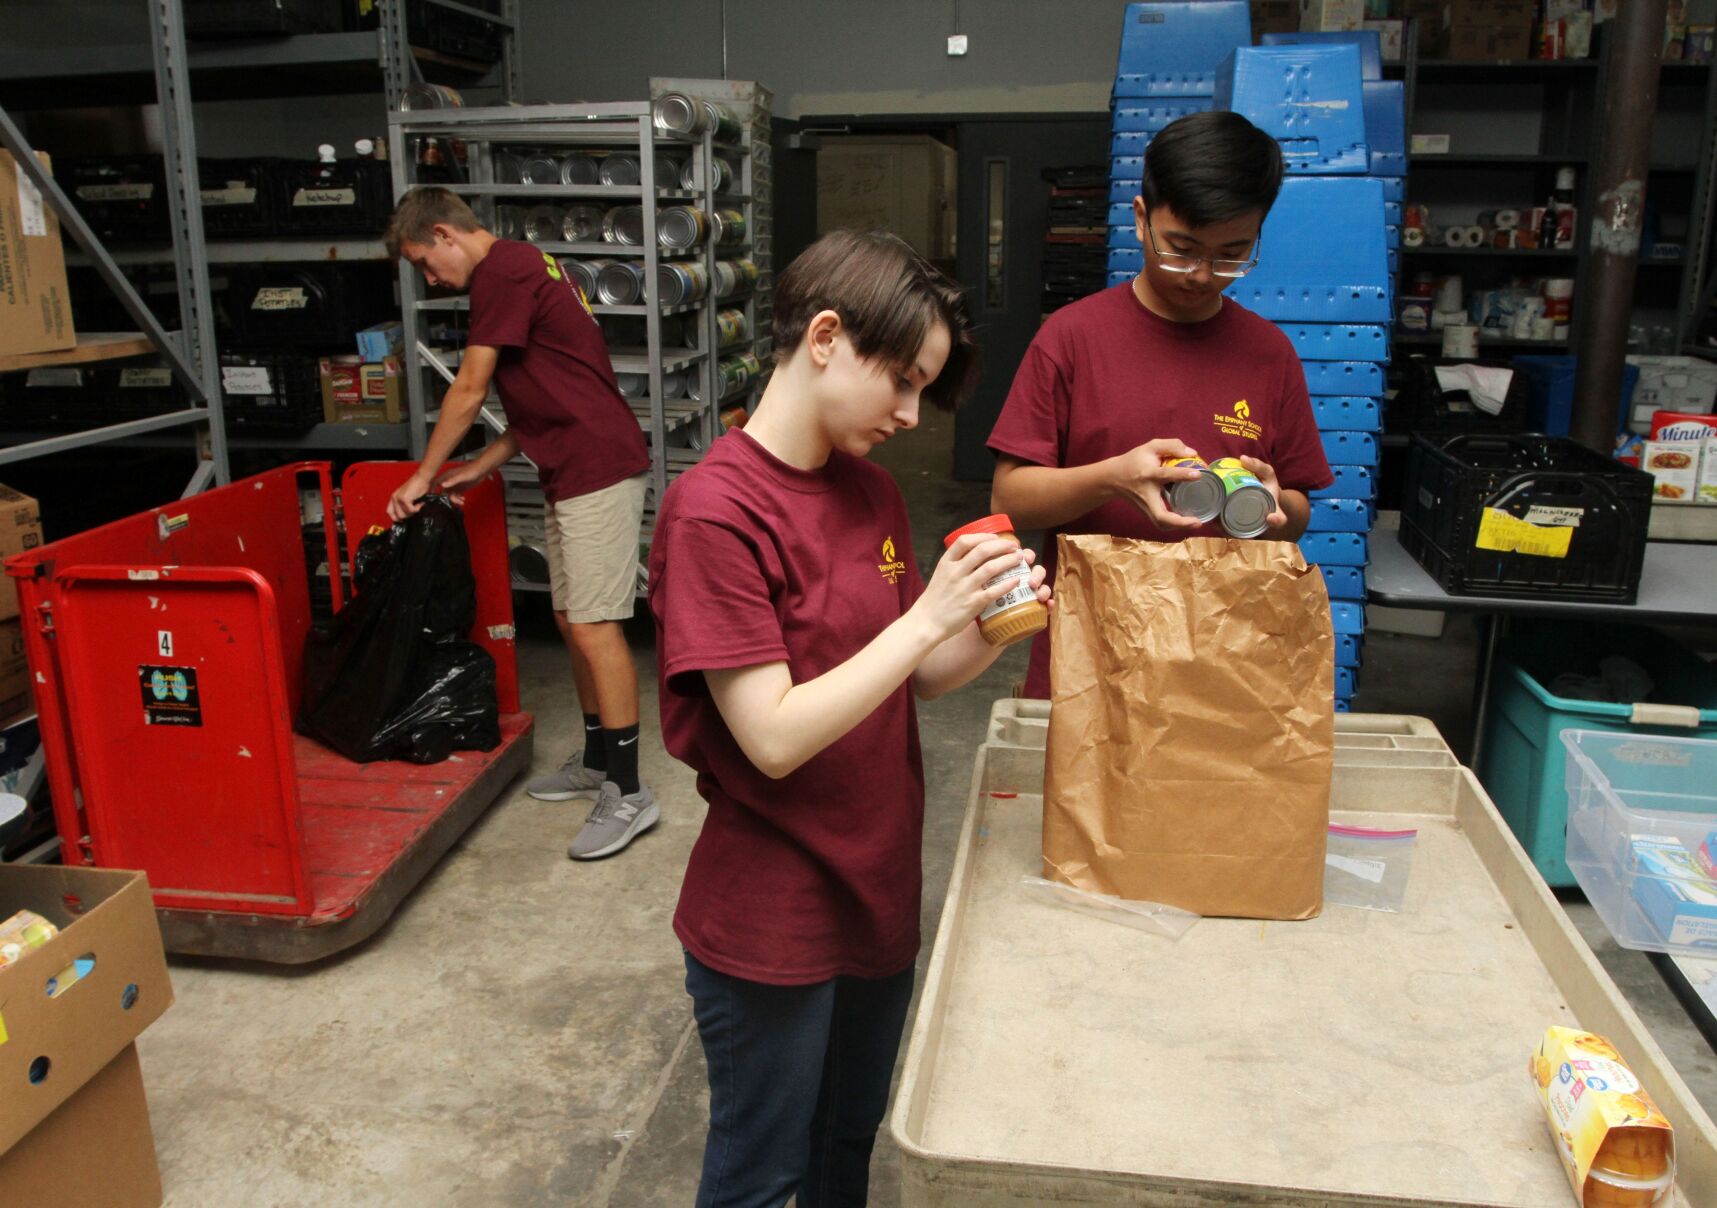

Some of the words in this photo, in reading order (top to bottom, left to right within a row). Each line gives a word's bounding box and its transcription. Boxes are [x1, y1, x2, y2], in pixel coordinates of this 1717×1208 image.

[306, 192, 342, 203] Ketchup
[1, 243, 16, 305] CALIENTES
[1660, 426, 1716, 441] Minute
[161, 633, 170, 655] 4
